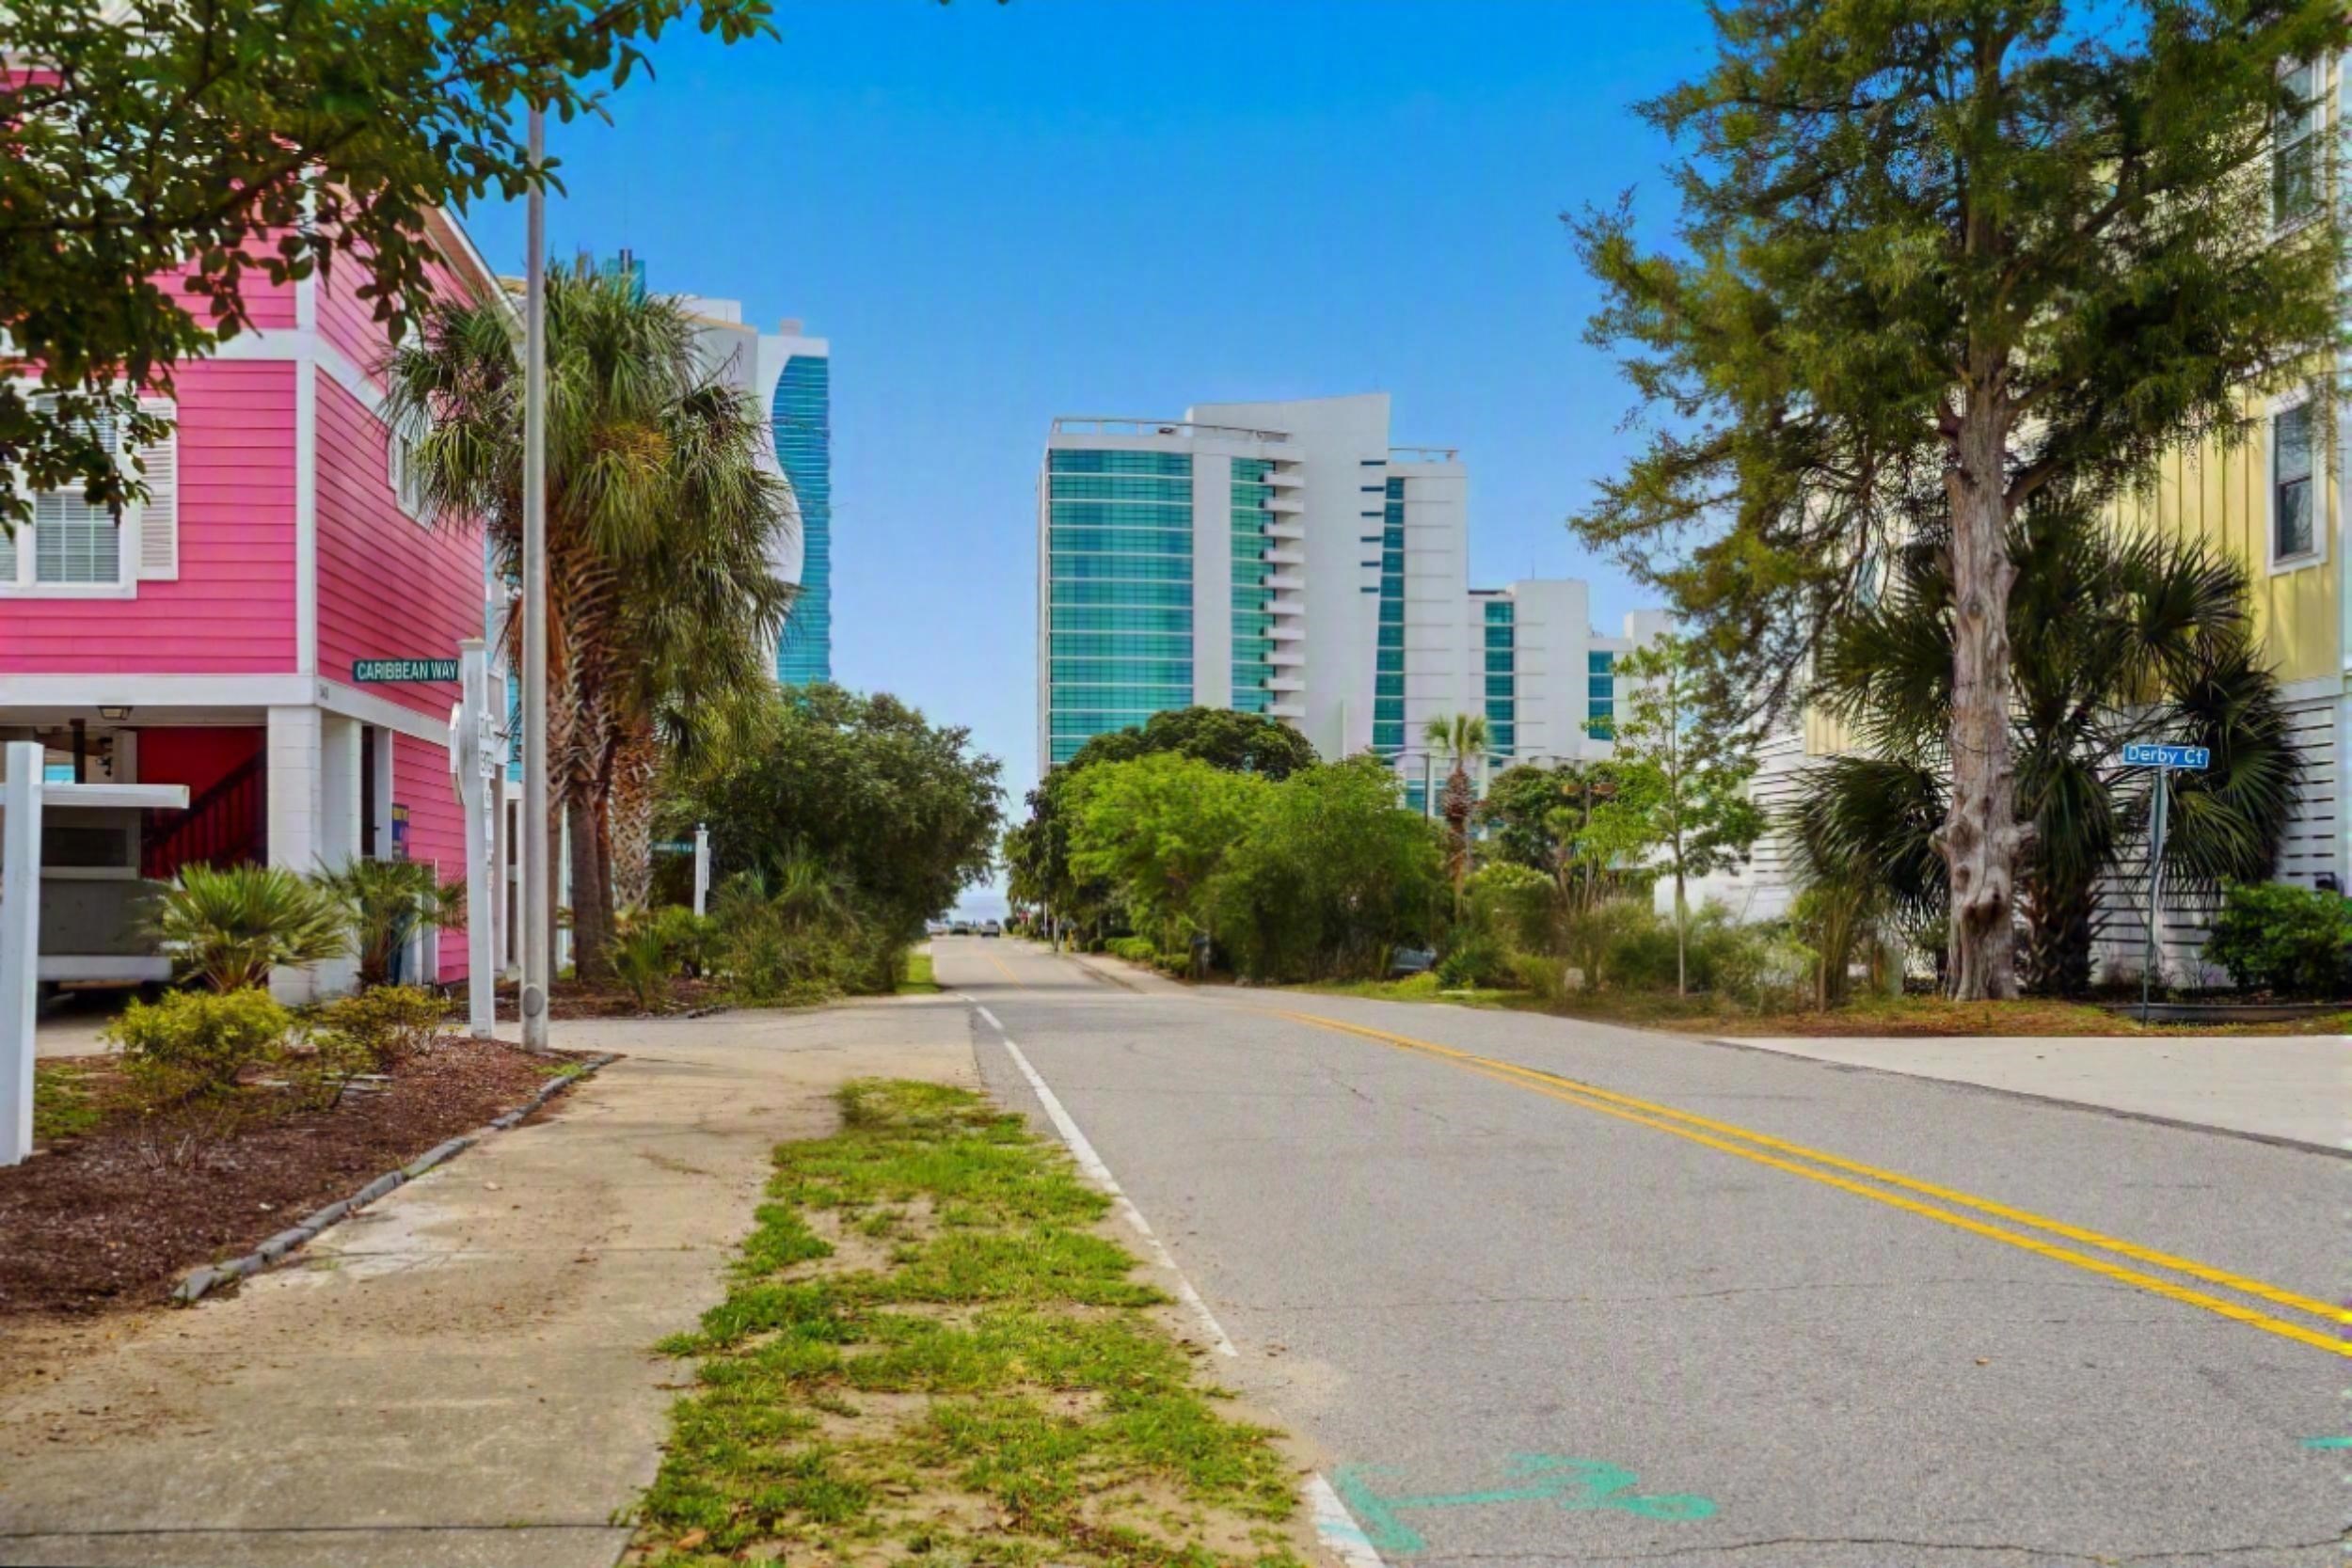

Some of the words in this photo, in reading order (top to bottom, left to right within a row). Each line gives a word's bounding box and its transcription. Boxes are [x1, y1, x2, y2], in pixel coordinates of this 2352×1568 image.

[358, 661, 428, 680] CARIBBEAN
[431, 661, 456, 679] WAY
[2128, 746, 2178, 764] Derby
[2185, 750, 2202, 764] Ct
